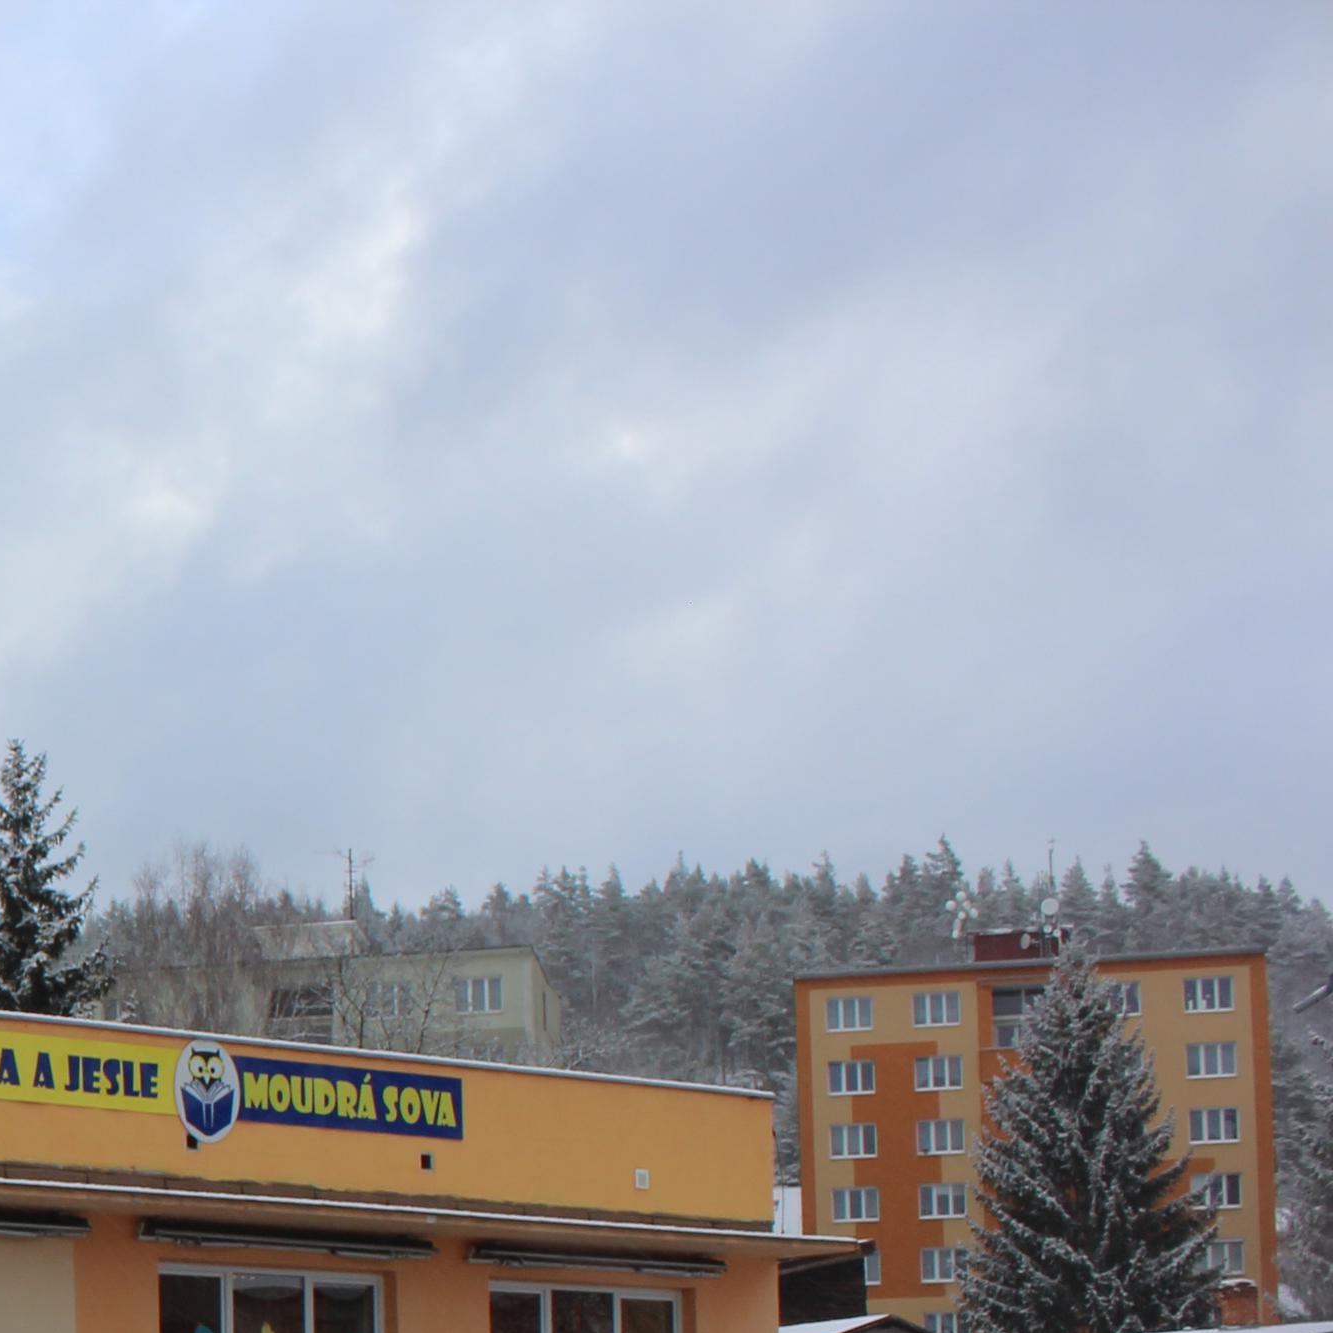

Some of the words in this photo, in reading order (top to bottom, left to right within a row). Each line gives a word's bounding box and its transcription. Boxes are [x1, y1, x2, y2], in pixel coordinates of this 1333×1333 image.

[33, 1051, 55, 1090] A
[64, 1054, 159, 1099] JESLE
[243, 1072, 377, 1121] MOUDRÁ
[383, 1085, 457, 1127] SOVA
